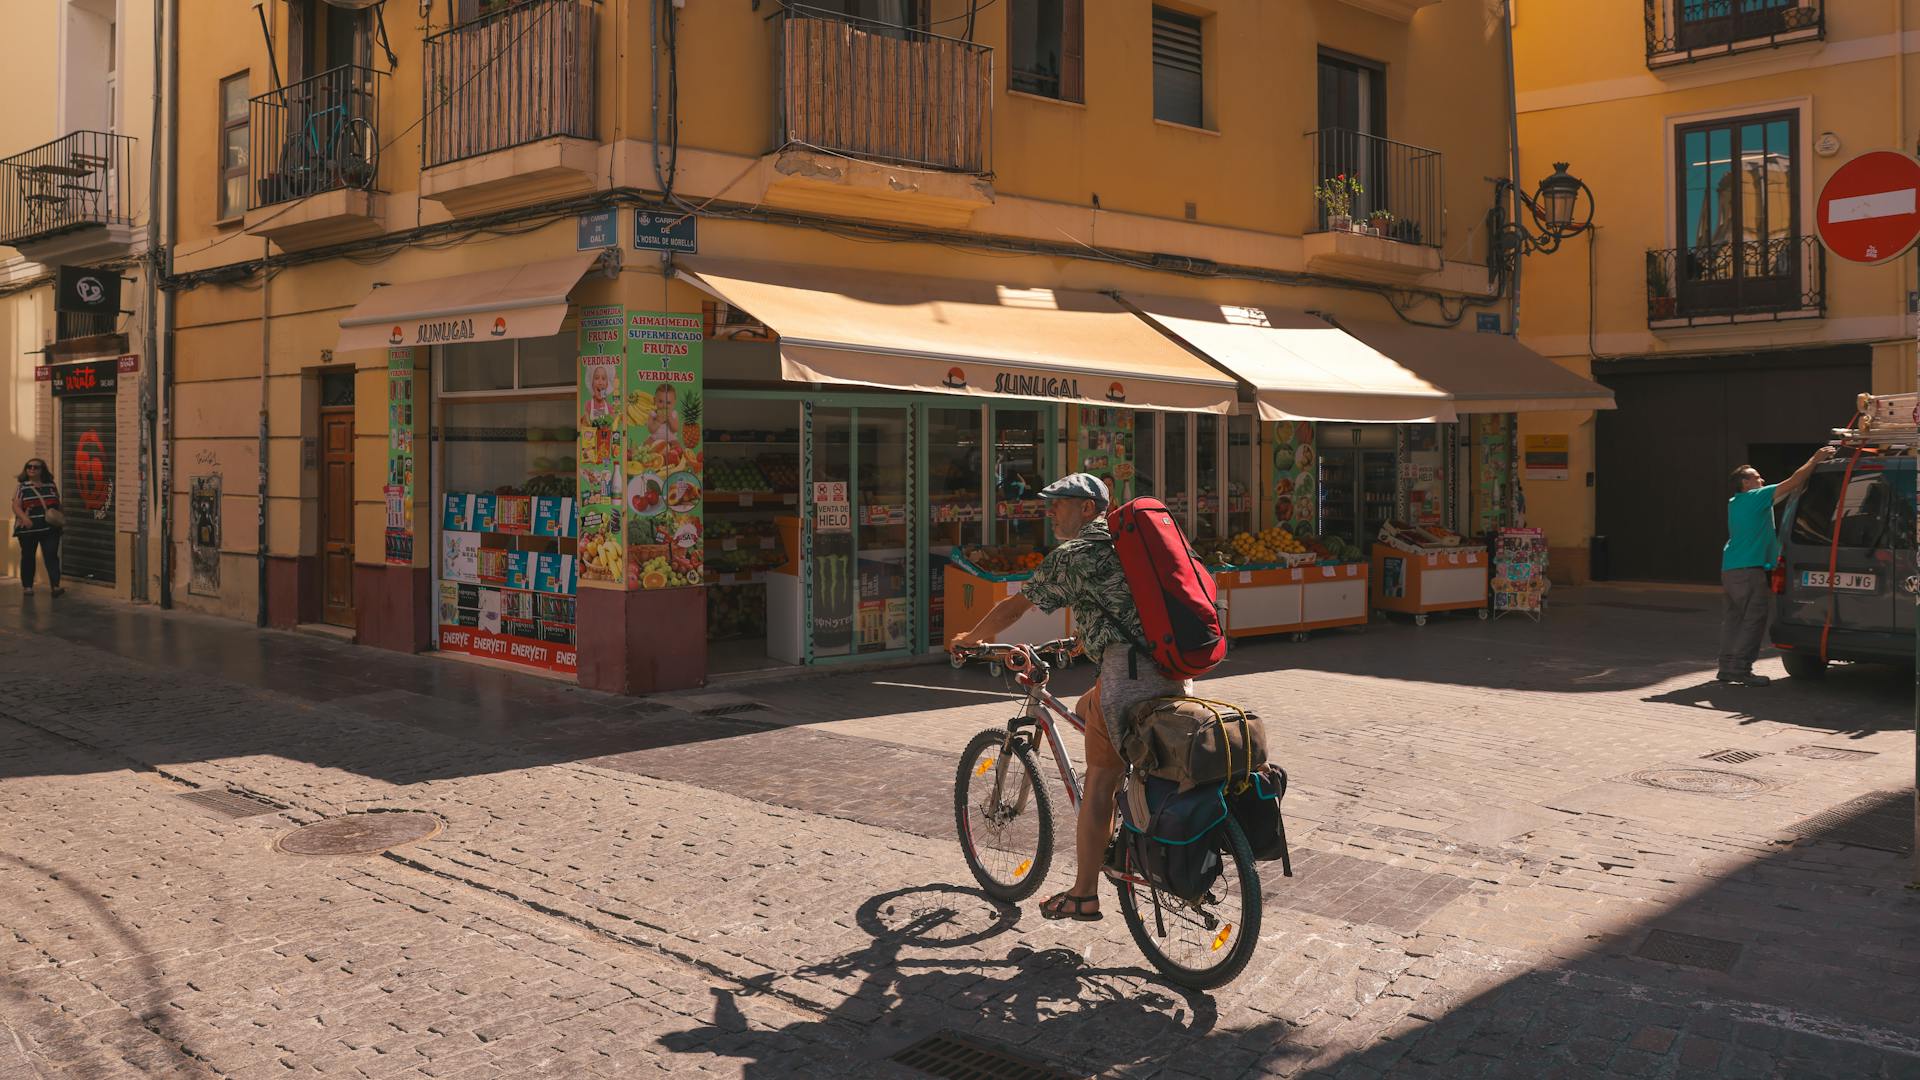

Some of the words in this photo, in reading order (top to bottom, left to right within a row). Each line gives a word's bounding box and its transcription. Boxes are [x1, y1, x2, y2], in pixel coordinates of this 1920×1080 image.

[662, 237, 669, 245] DE
[671, 238, 694, 247] MORELLA
[631, 316, 700, 328] AHMADMEDIA
[416, 319, 475, 343] SUNUGAL
[588, 331, 618, 341] FRUTAS
[629, 329, 702, 341] SUPERMERCADO
[643, 343, 688, 355] FRUTAS
[582, 355, 620, 366] VERDURAS
[662, 358, 669, 368] Y
[638, 371, 694, 382] VERDURAS
[994, 373, 1081, 398] SUNUGAL
[820, 515, 847, 526] HIELO
[1846, 575, 1871, 588] JWG
[474, 637, 507, 654] ENERYETI
[511, 643, 547, 661] ENERYETI
